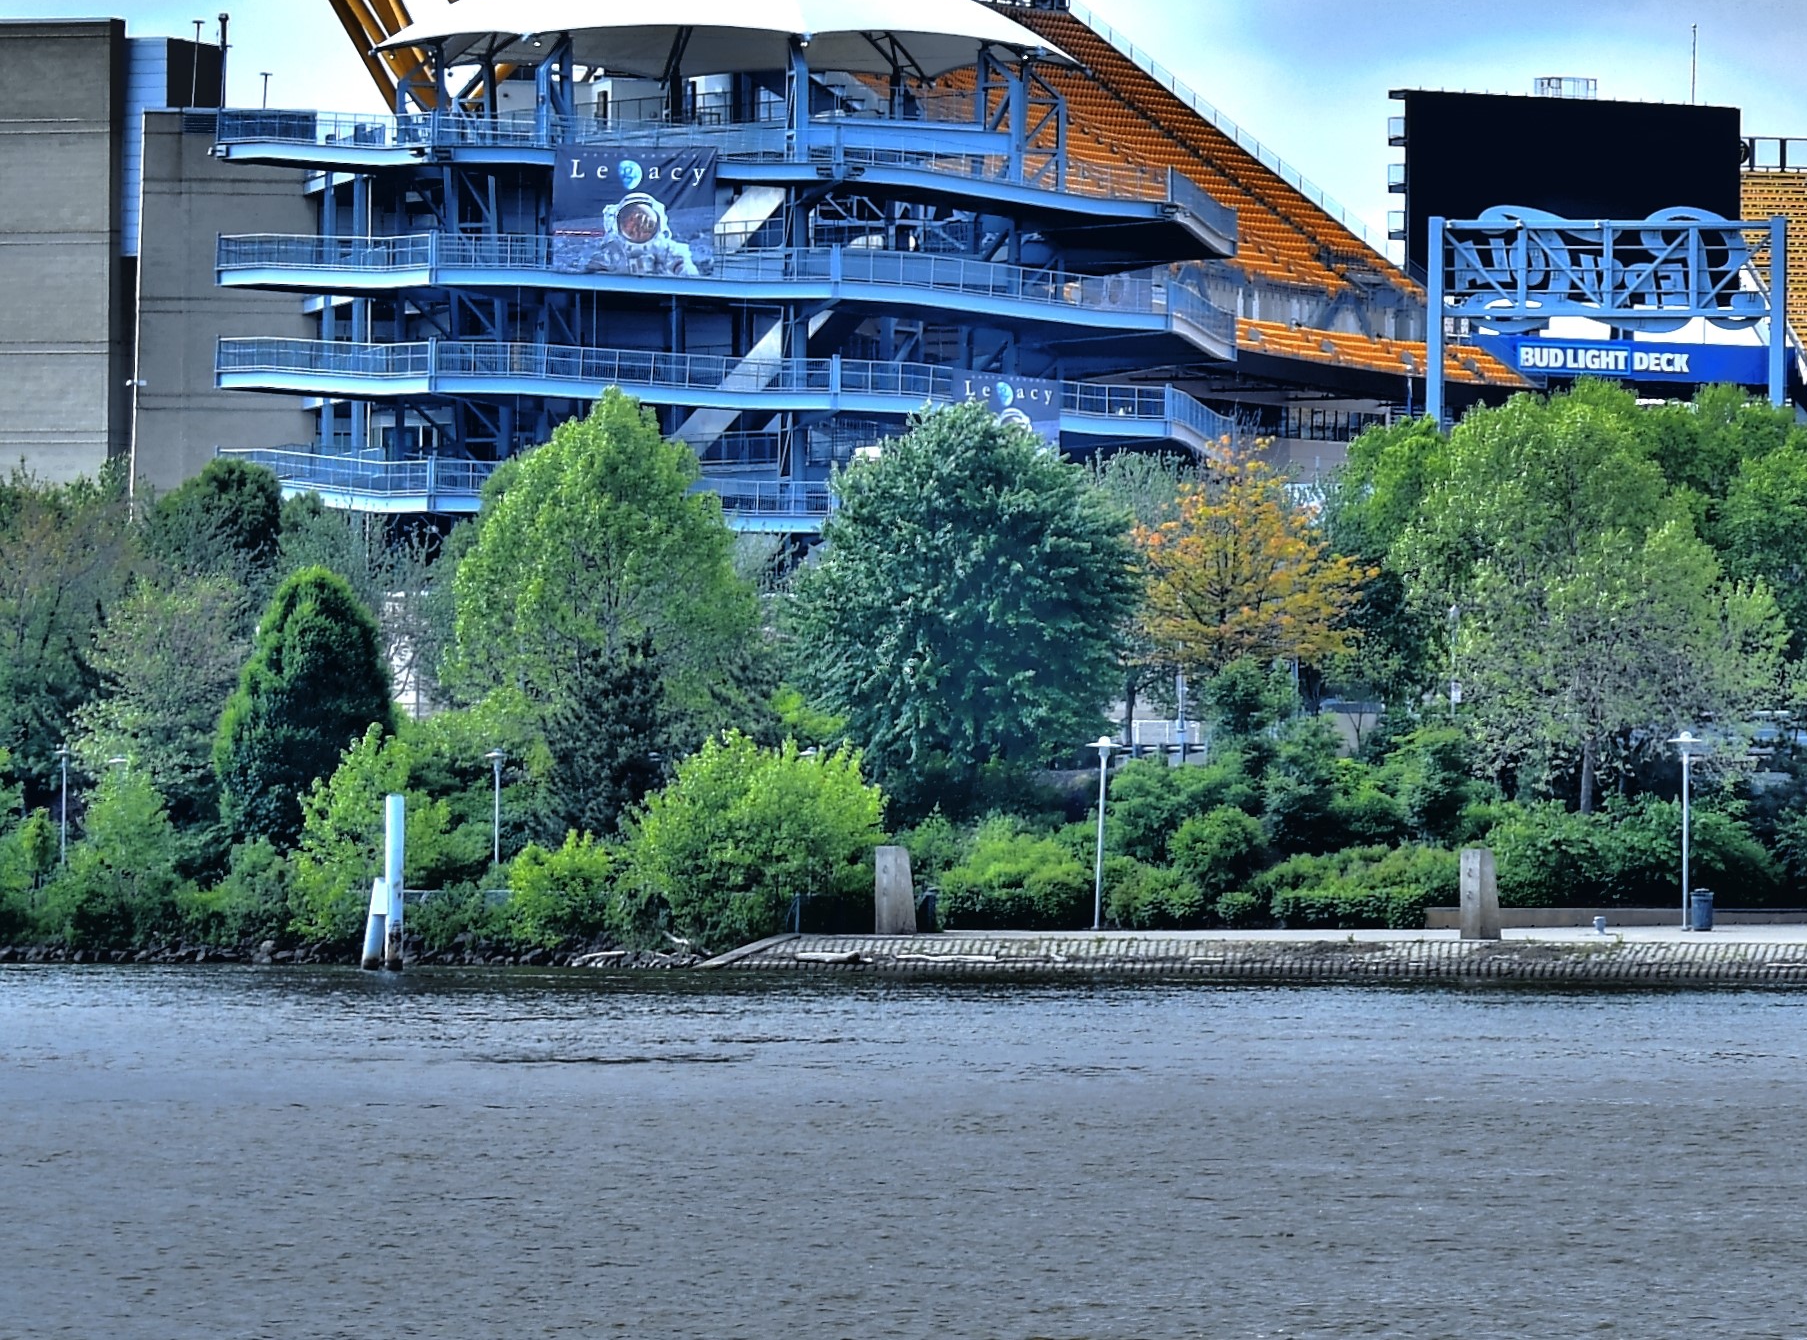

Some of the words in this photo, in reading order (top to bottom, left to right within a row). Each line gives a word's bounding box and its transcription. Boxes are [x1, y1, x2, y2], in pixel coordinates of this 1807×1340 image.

[570, 159, 706, 187] Legacy
[1520, 346, 1564, 368] BUD
[1566, 348, 1628, 370] LIGHT
[1633, 351, 1690, 373] DECK
